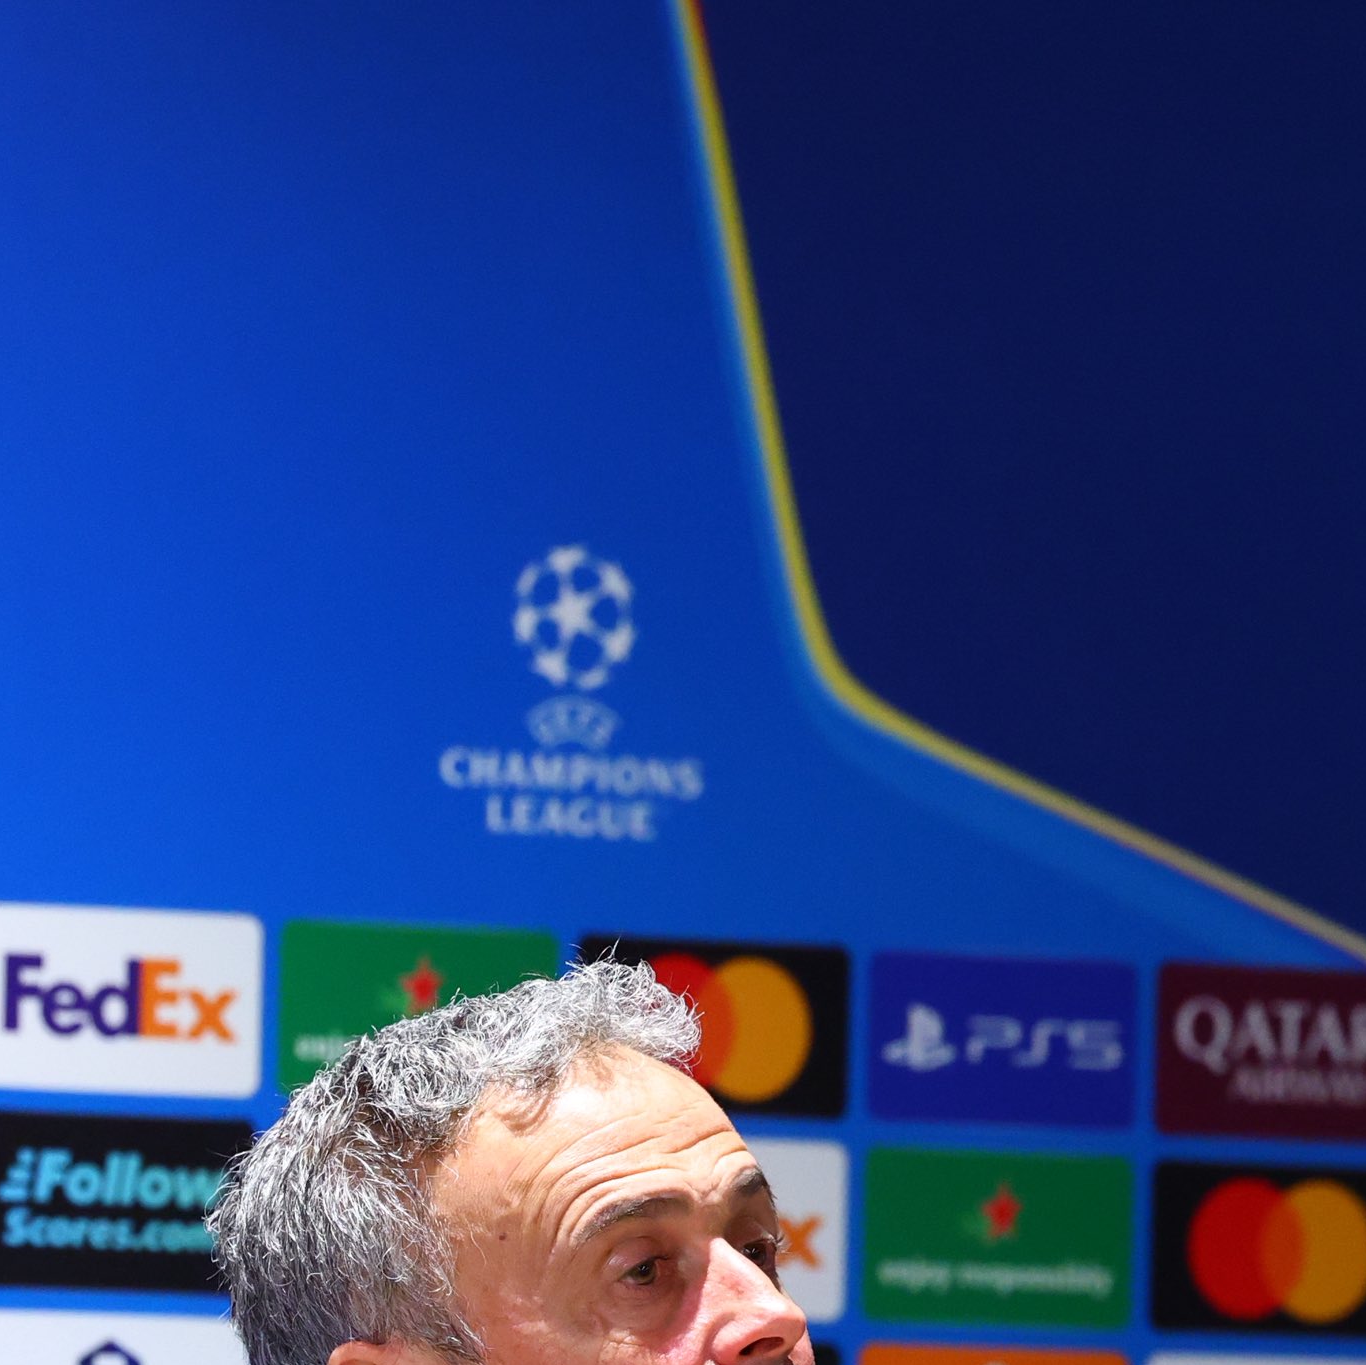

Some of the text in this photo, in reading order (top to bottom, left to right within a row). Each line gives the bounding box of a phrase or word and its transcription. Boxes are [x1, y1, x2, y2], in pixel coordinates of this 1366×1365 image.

[439, 745, 704, 800] CHAMPIONS
[486, 794, 656, 841] LEAGUE
[3, 954, 237, 1043] FedEx
[965, 1015, 1124, 1071] PS5
